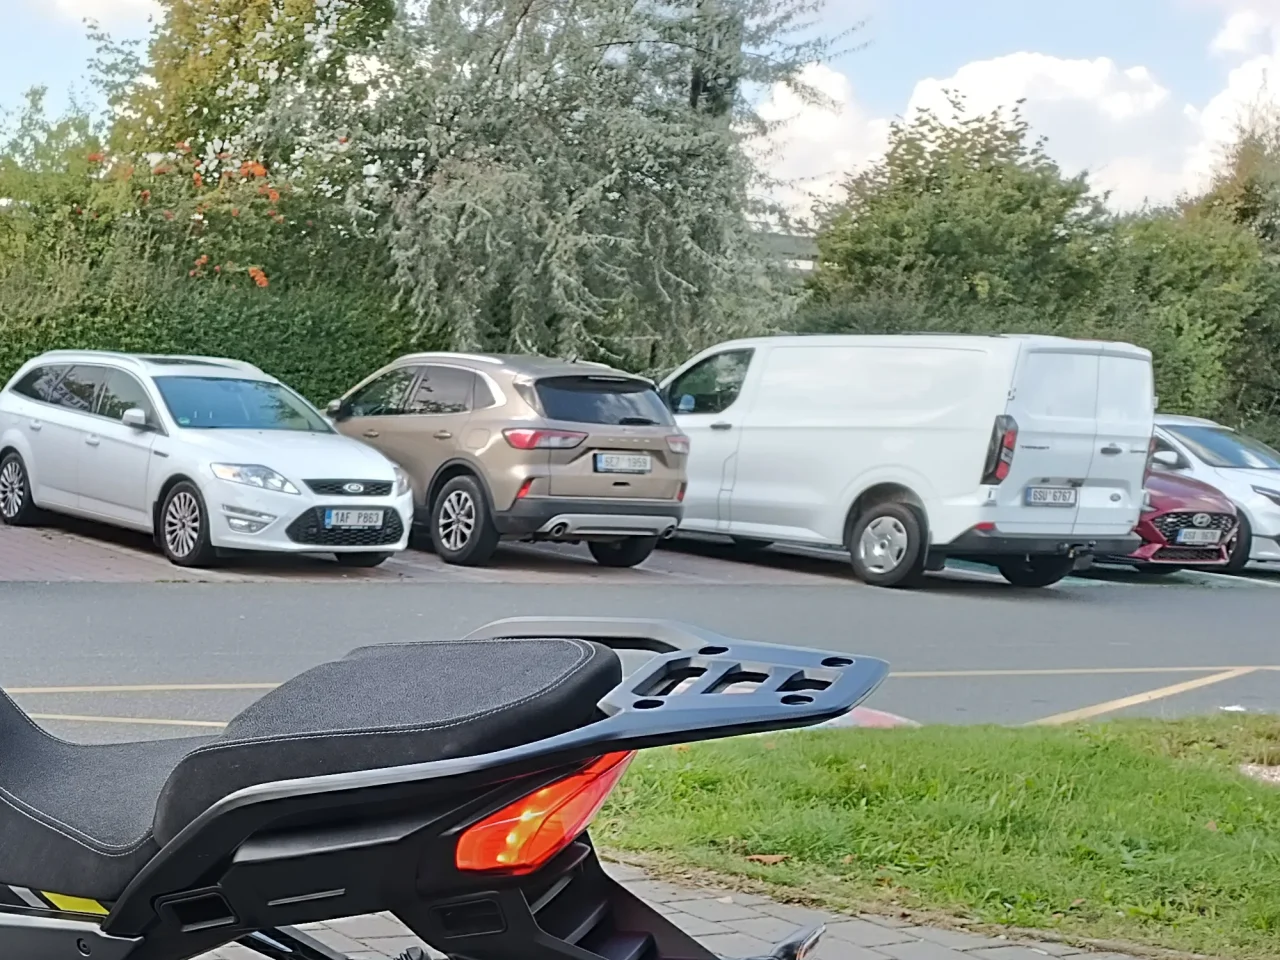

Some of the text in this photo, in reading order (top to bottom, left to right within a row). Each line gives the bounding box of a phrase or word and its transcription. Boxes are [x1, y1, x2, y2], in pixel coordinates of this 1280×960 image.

[1032, 489, 1073, 501] 6SU 6767
[334, 511, 351, 524] 1AF
